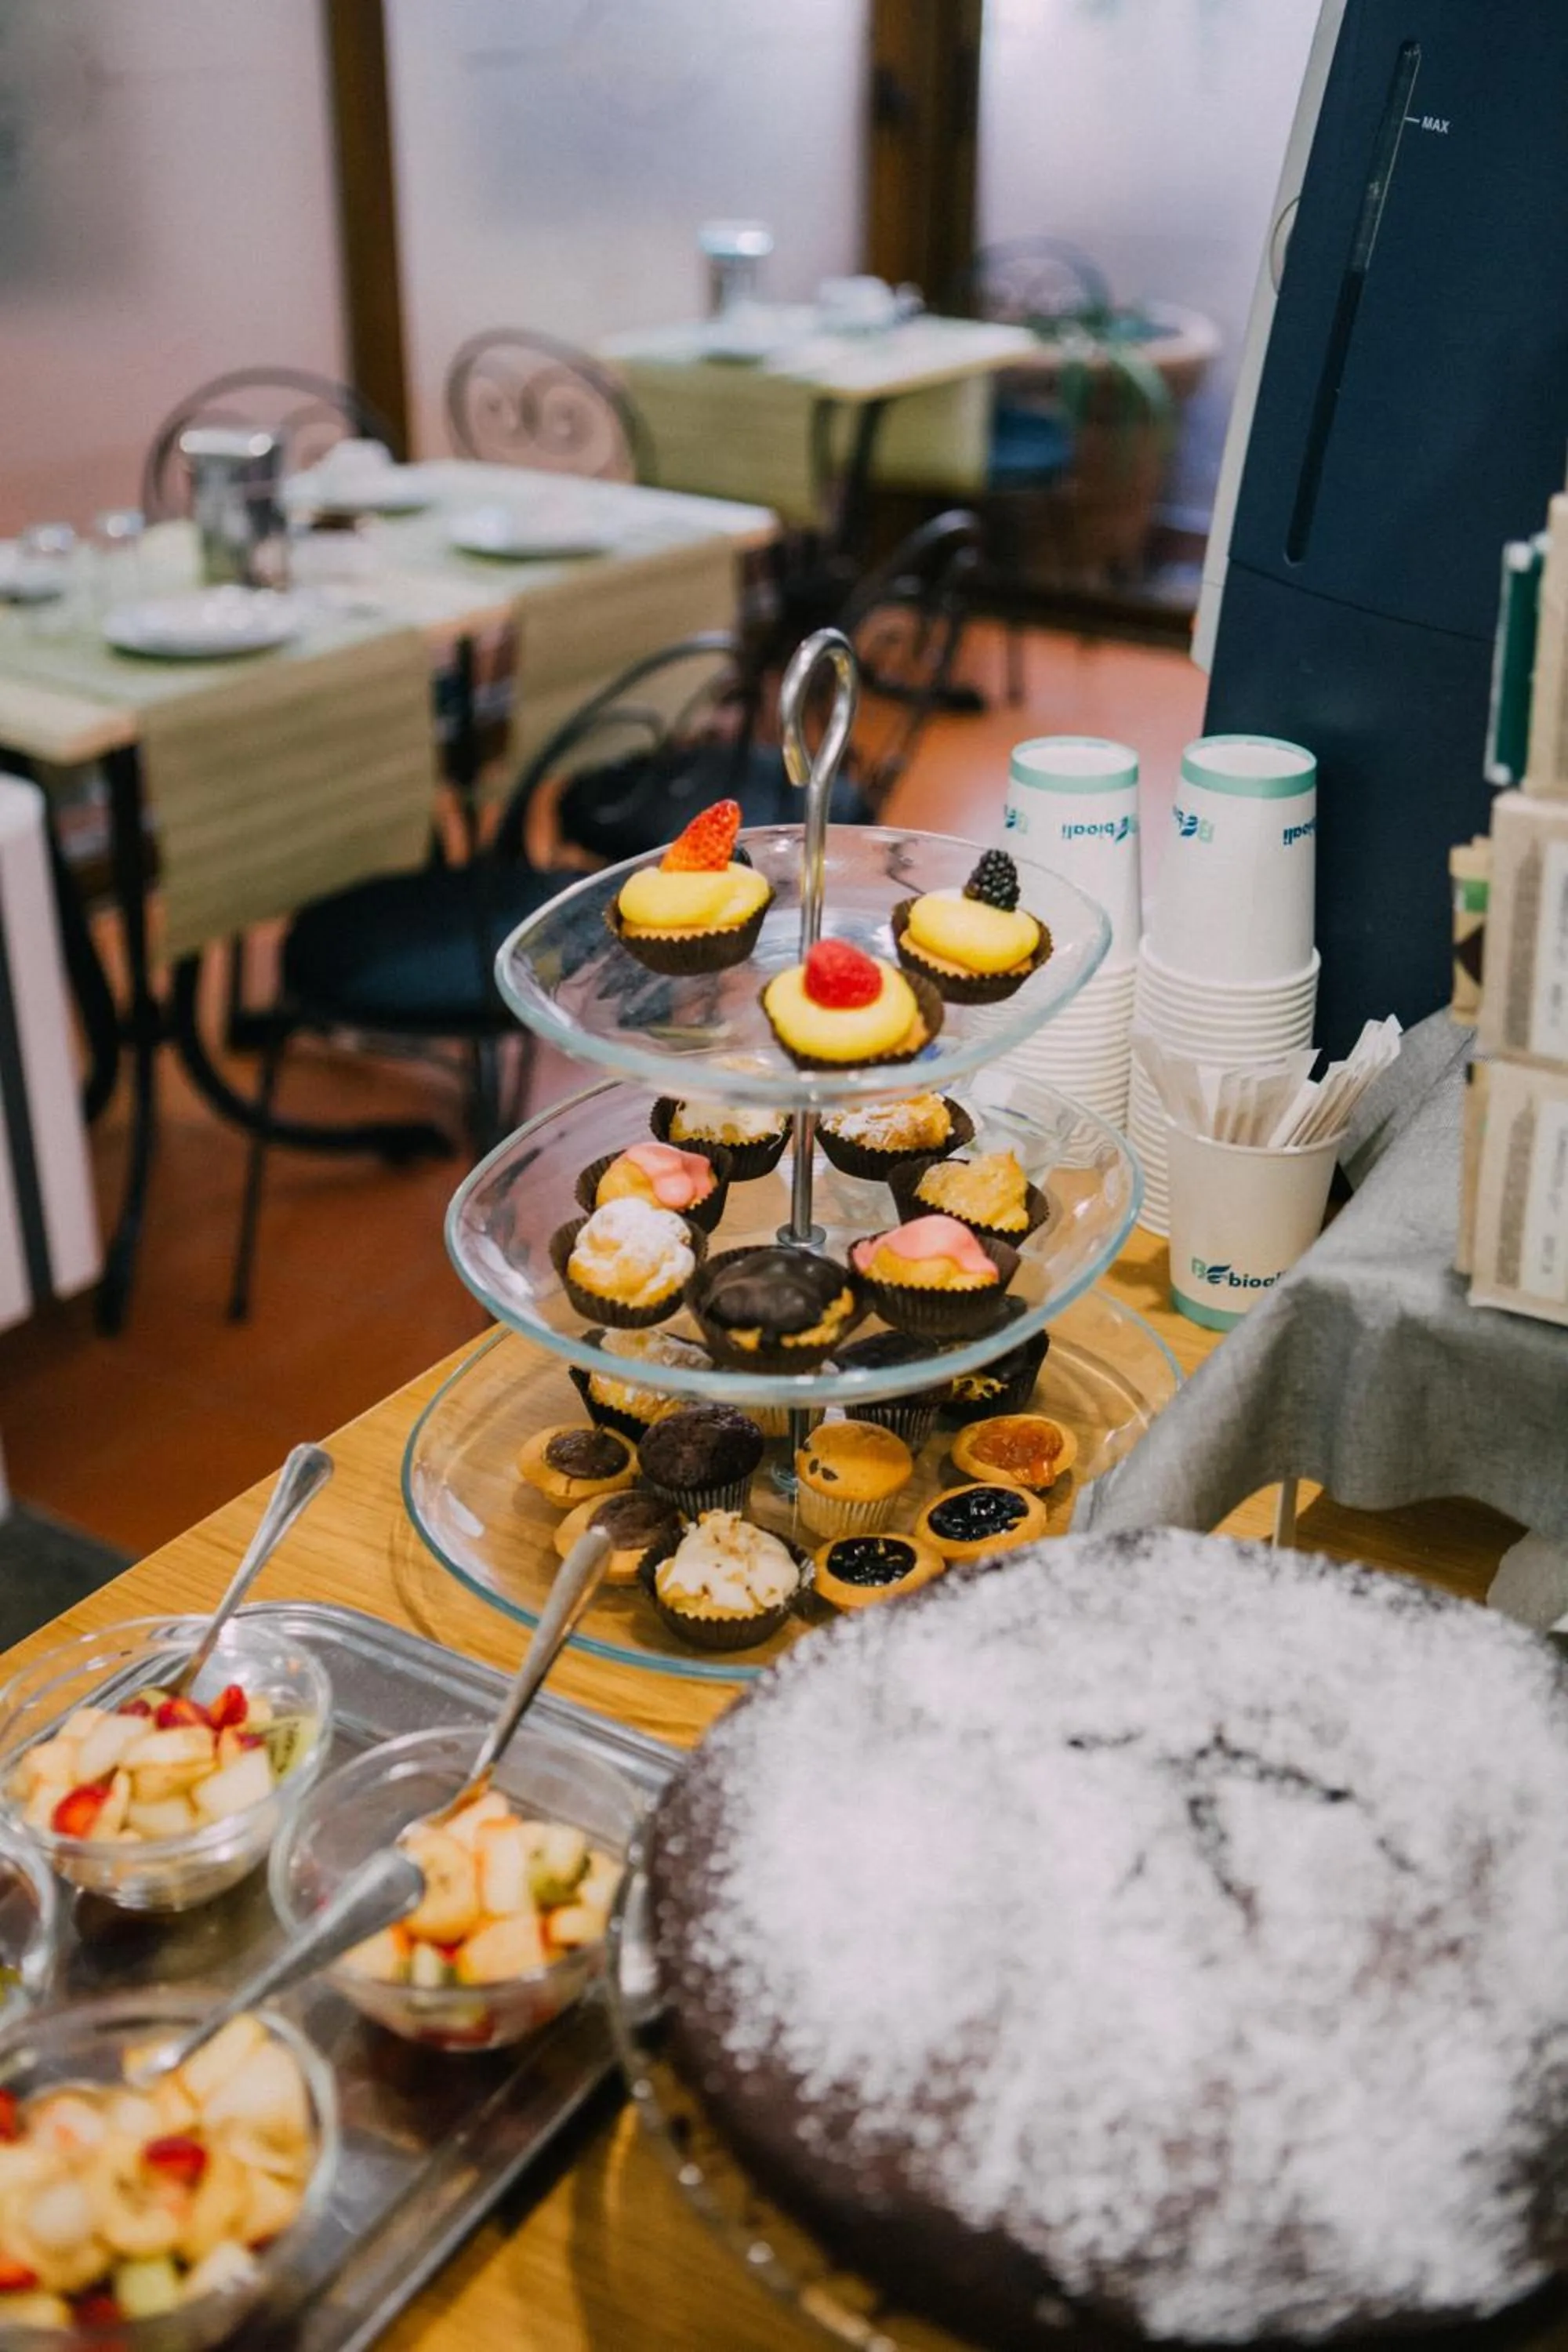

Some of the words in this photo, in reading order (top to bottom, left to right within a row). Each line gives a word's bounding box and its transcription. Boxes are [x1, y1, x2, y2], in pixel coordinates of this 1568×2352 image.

[1421, 115, 1450, 134] MAX
[1062, 822, 1114, 840] bioali
[1229, 1271, 1287, 1287] bioa
